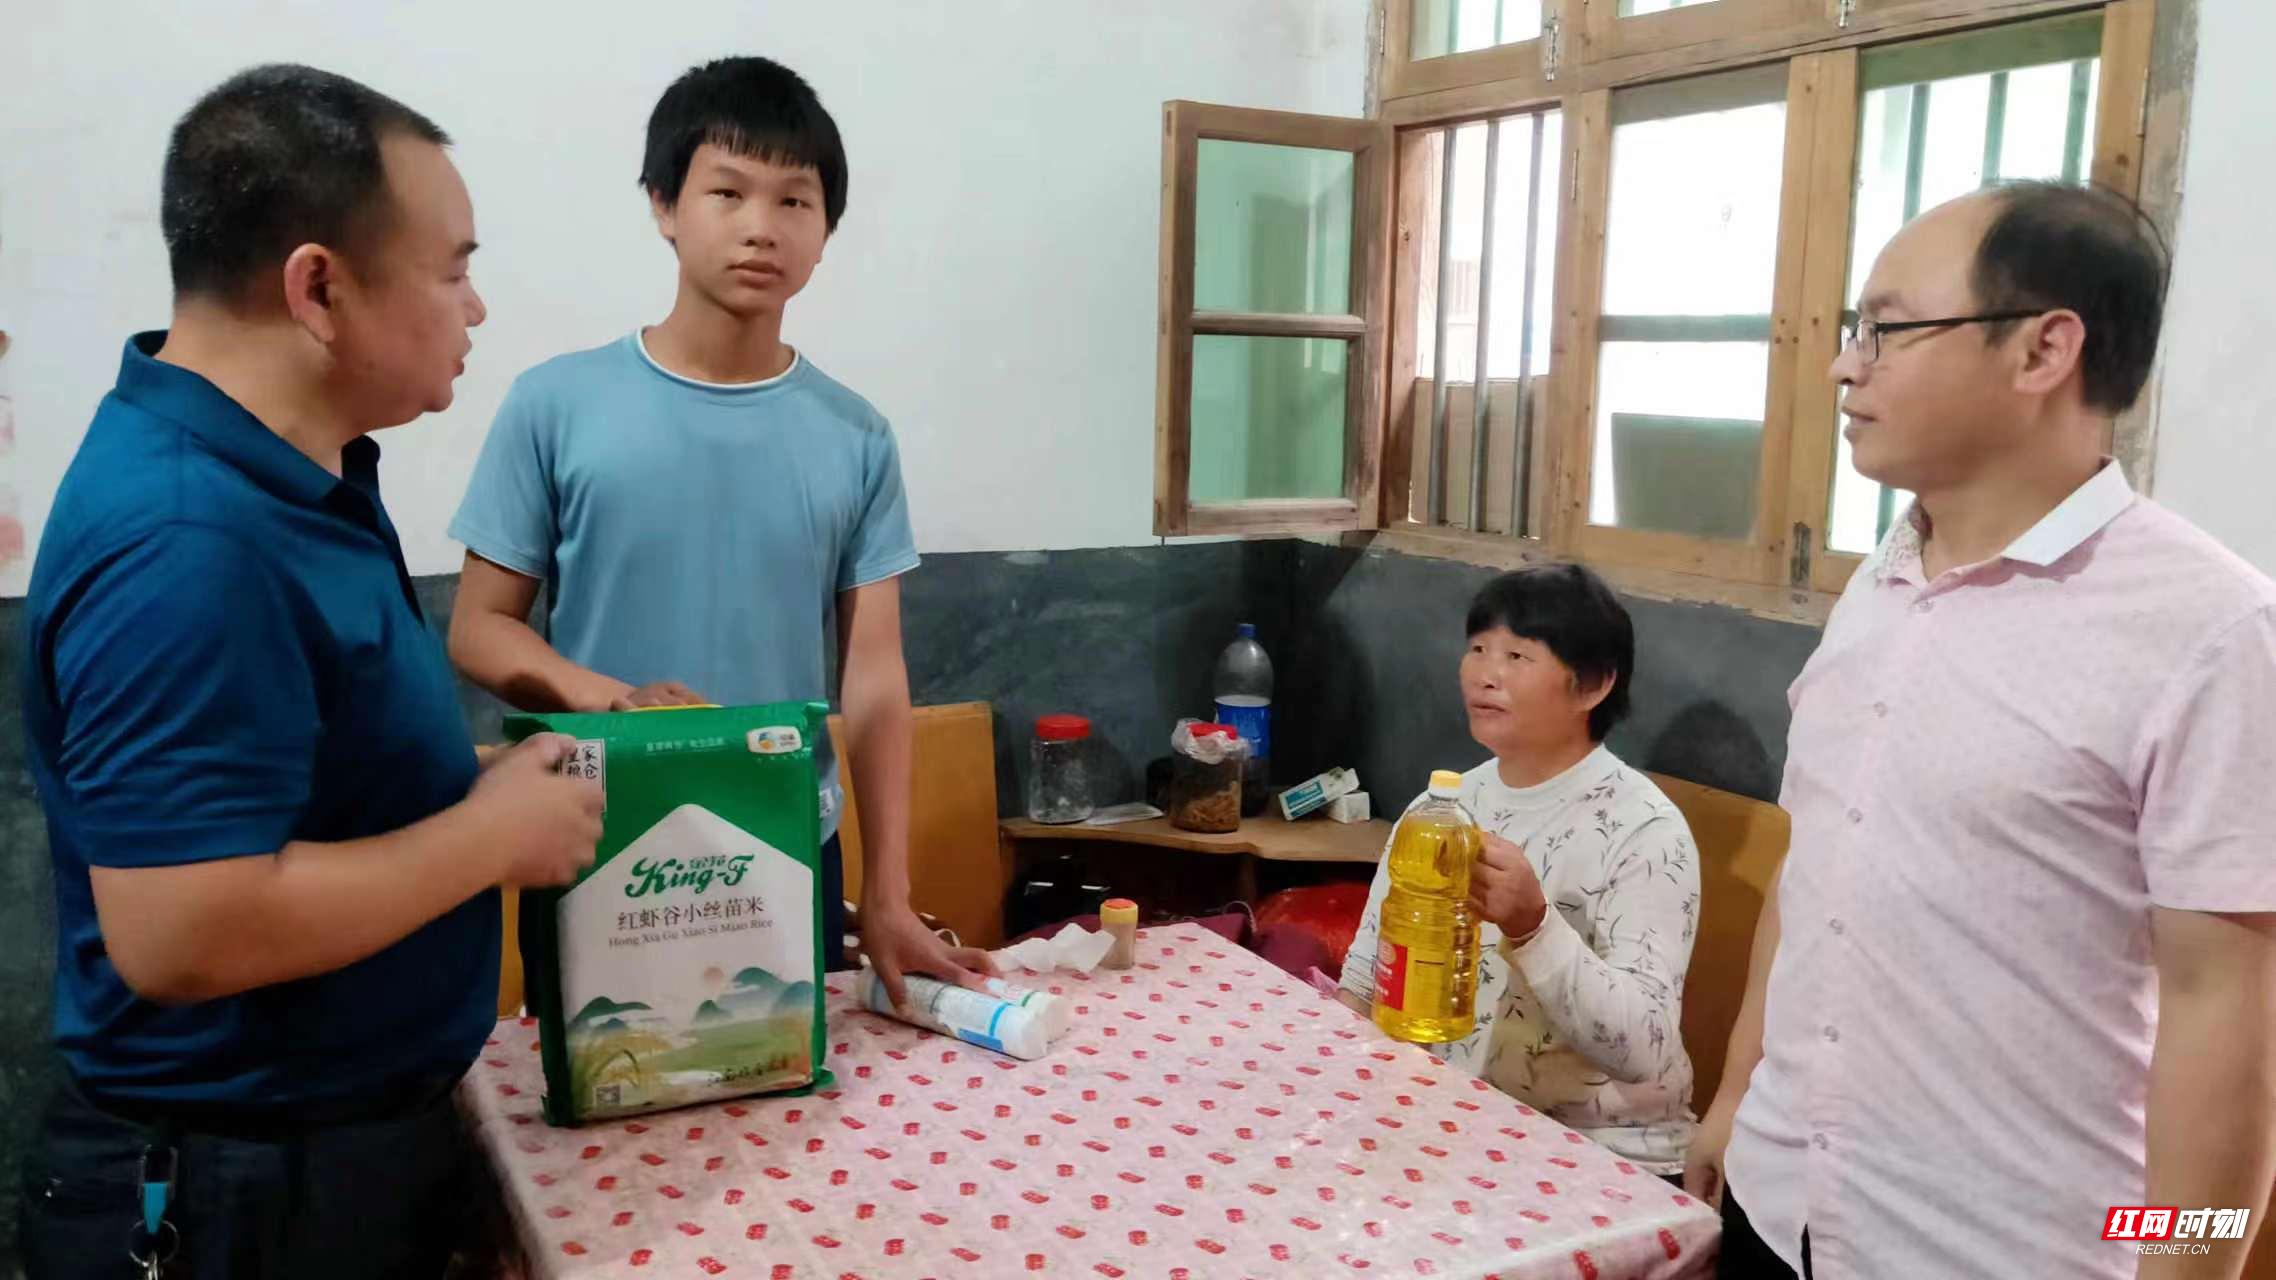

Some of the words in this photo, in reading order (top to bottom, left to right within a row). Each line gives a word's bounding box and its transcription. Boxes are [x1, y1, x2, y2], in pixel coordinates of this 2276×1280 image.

[624, 854, 755, 898] King-F
[617, 896, 765, 931] 红虾谷小丝苗米
[608, 935, 640, 948] Hong
[750, 918, 774, 930] Rice
